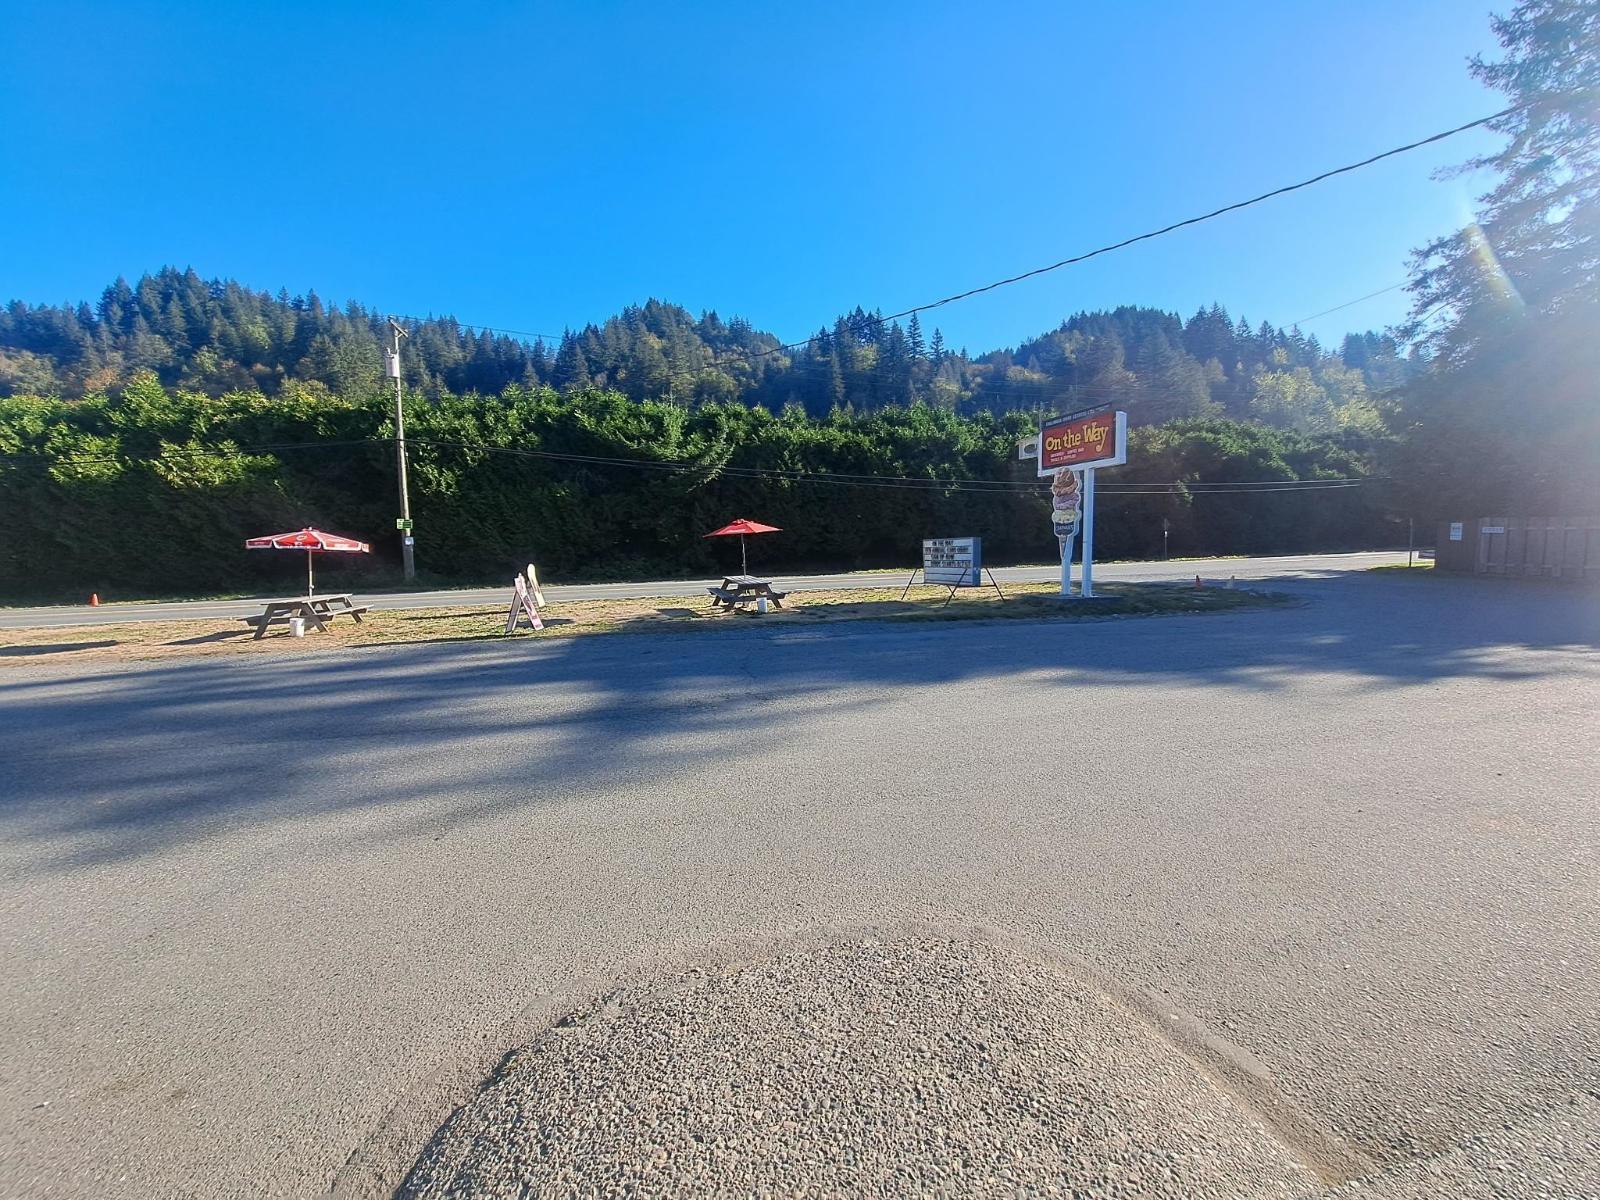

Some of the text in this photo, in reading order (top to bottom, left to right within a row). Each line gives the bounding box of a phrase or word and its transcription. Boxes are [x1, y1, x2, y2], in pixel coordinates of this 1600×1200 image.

[1045, 422, 1109, 452] On the Way
